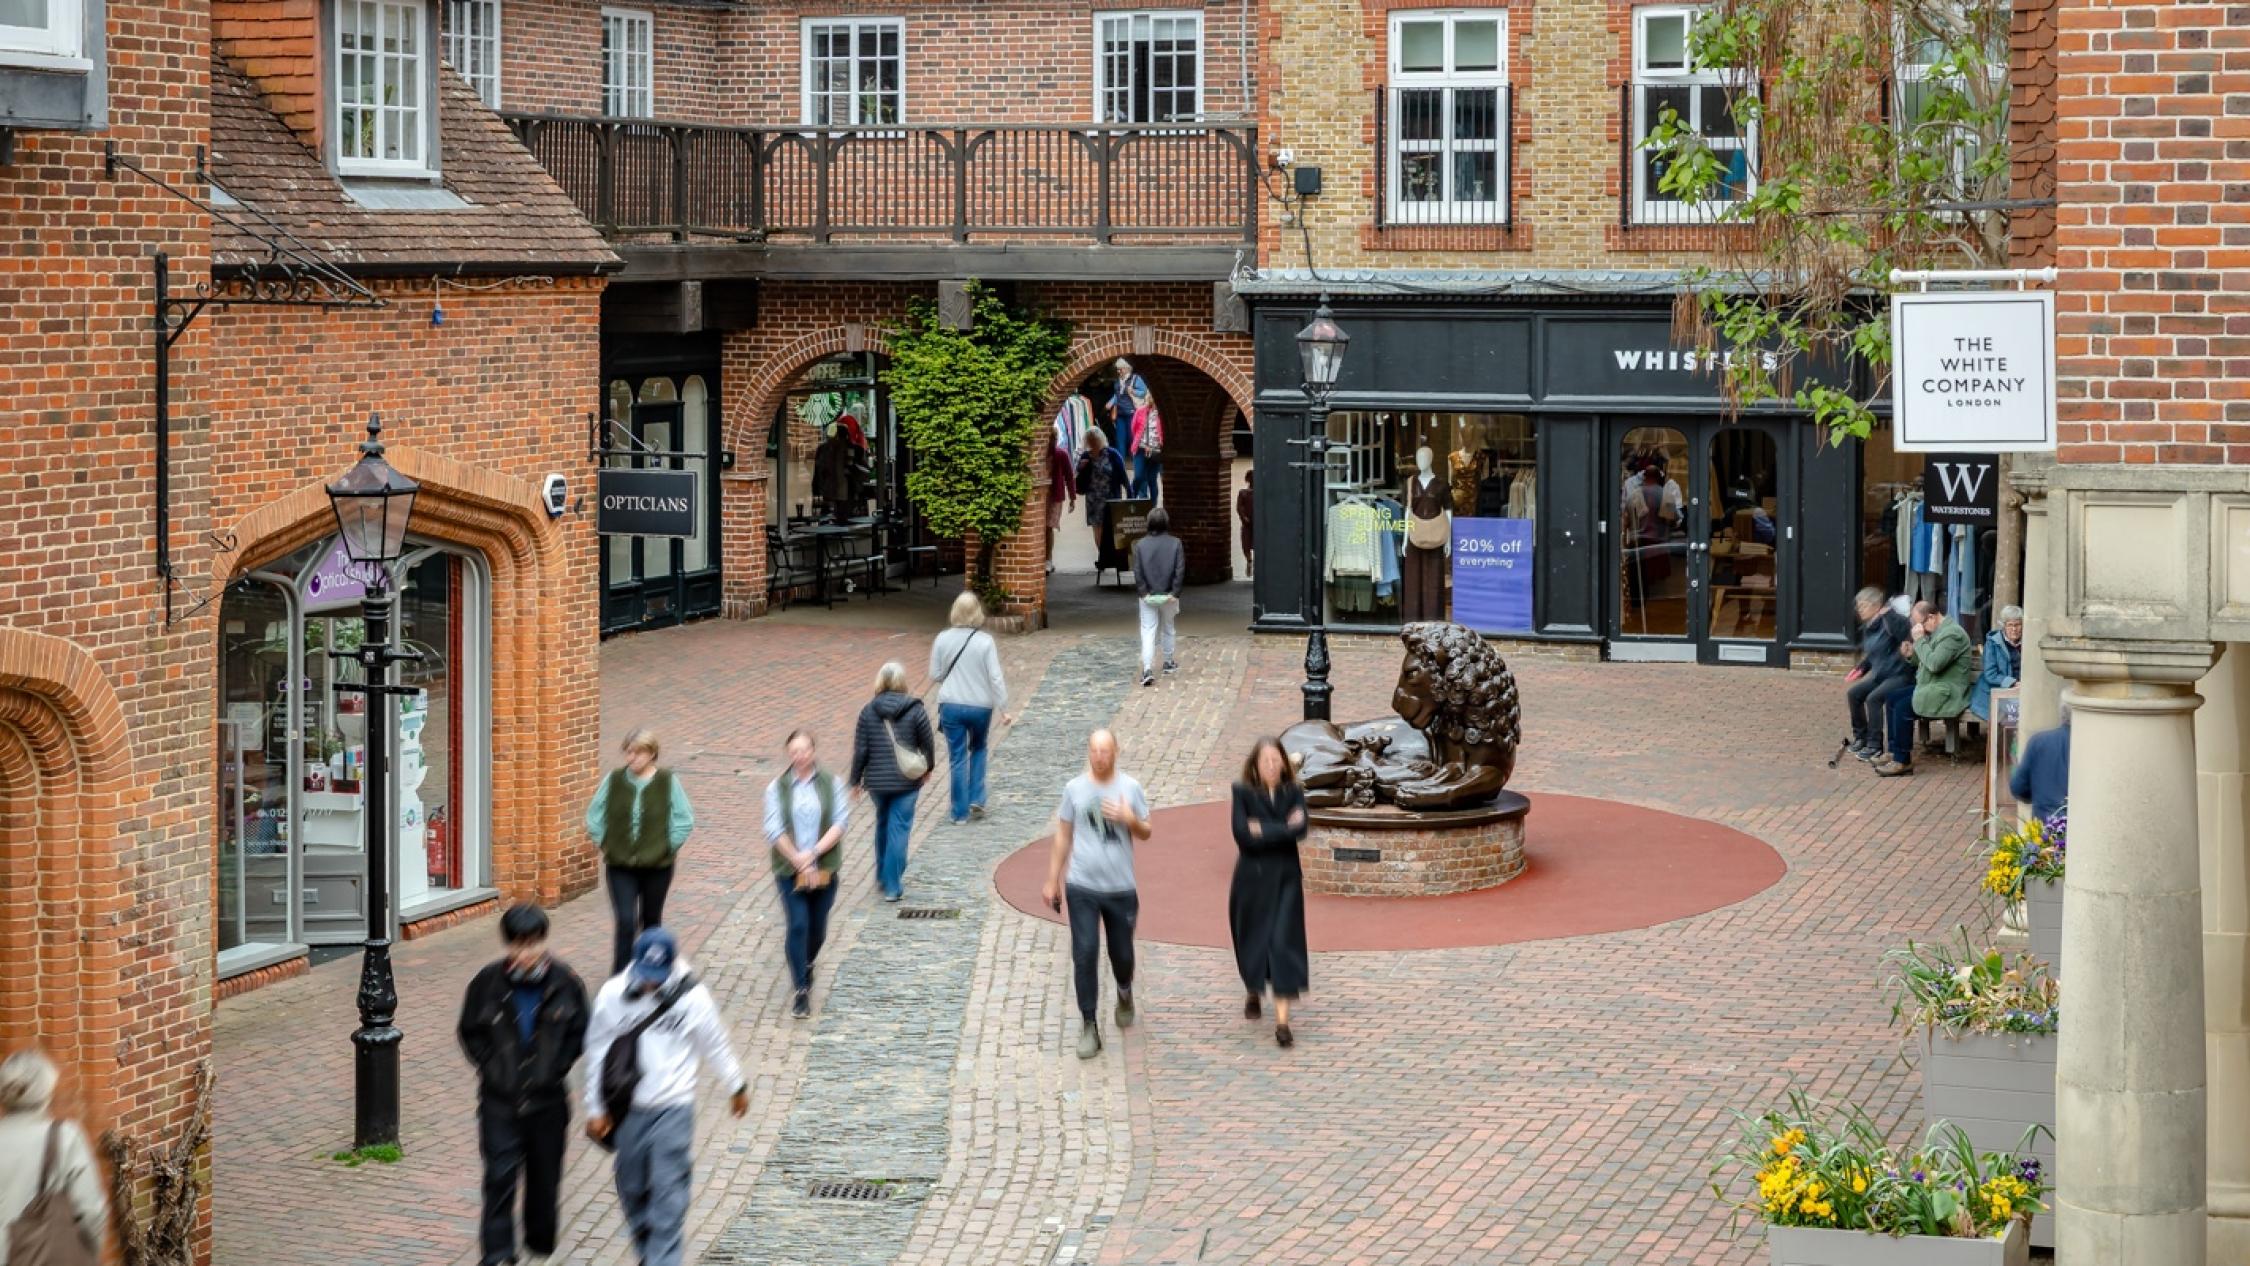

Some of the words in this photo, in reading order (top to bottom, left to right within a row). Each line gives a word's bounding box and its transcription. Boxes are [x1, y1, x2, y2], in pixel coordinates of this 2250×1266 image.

[1954, 337, 1992, 352] THE
[1940, 357, 2007, 372] WHITE
[1922, 377, 2025, 393] COMPANY
[1947, 398, 2001, 407] LONDON
[1932, 462, 1991, 503] W
[603, 494, 689, 512] OPTICIANS
[1931, 505, 1991, 516] WATERSTONES
[1340, 507, 1391, 519] SPRING
[1356, 519, 1415, 531] SUMMER
[1459, 538, 1495, 553] 20%
[1500, 539, 1522, 553] off
[1459, 556, 1514, 569] everything
